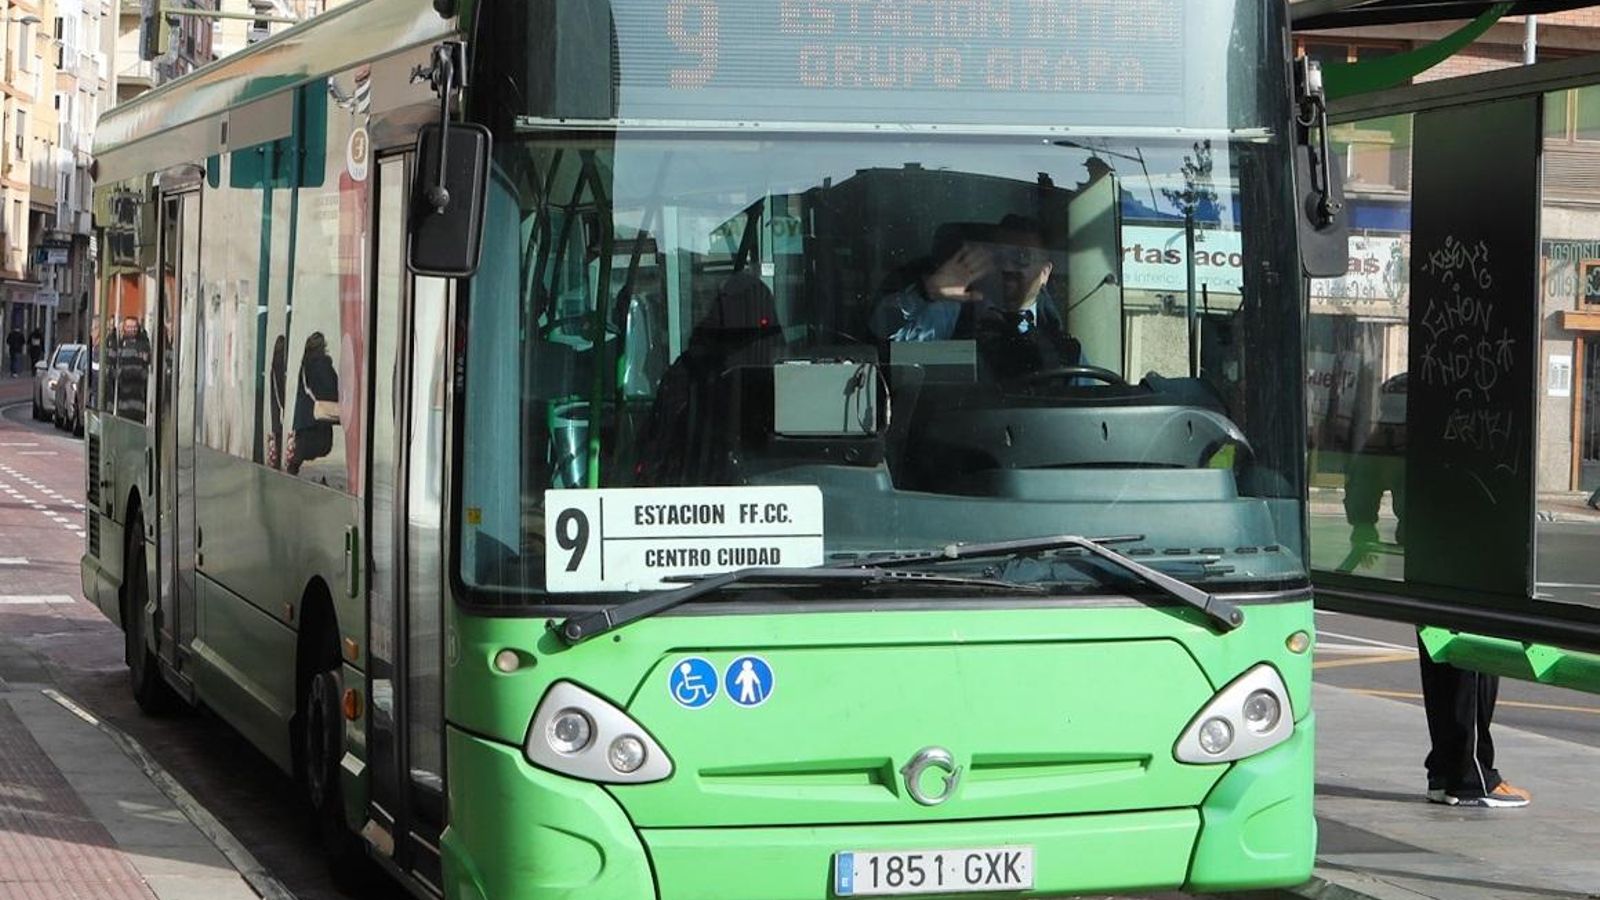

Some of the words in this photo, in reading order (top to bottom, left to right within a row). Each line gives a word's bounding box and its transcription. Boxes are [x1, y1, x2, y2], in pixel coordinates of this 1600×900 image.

[780, 0, 1013, 38] ESTACION
[666, 0, 719, 90] 9
[799, 45, 962, 88] GRUPO
[987, 47, 1145, 91] GRAPA
[634, 504, 725, 525] ESTACION
[739, 503, 793, 524] FF.CC.
[555, 507, 590, 572] 9
[645, 549, 711, 567] CENTRO
[717, 547, 781, 567] CIUDAD
[869, 855, 944, 888] 1851
[964, 851, 1022, 885] GXK
